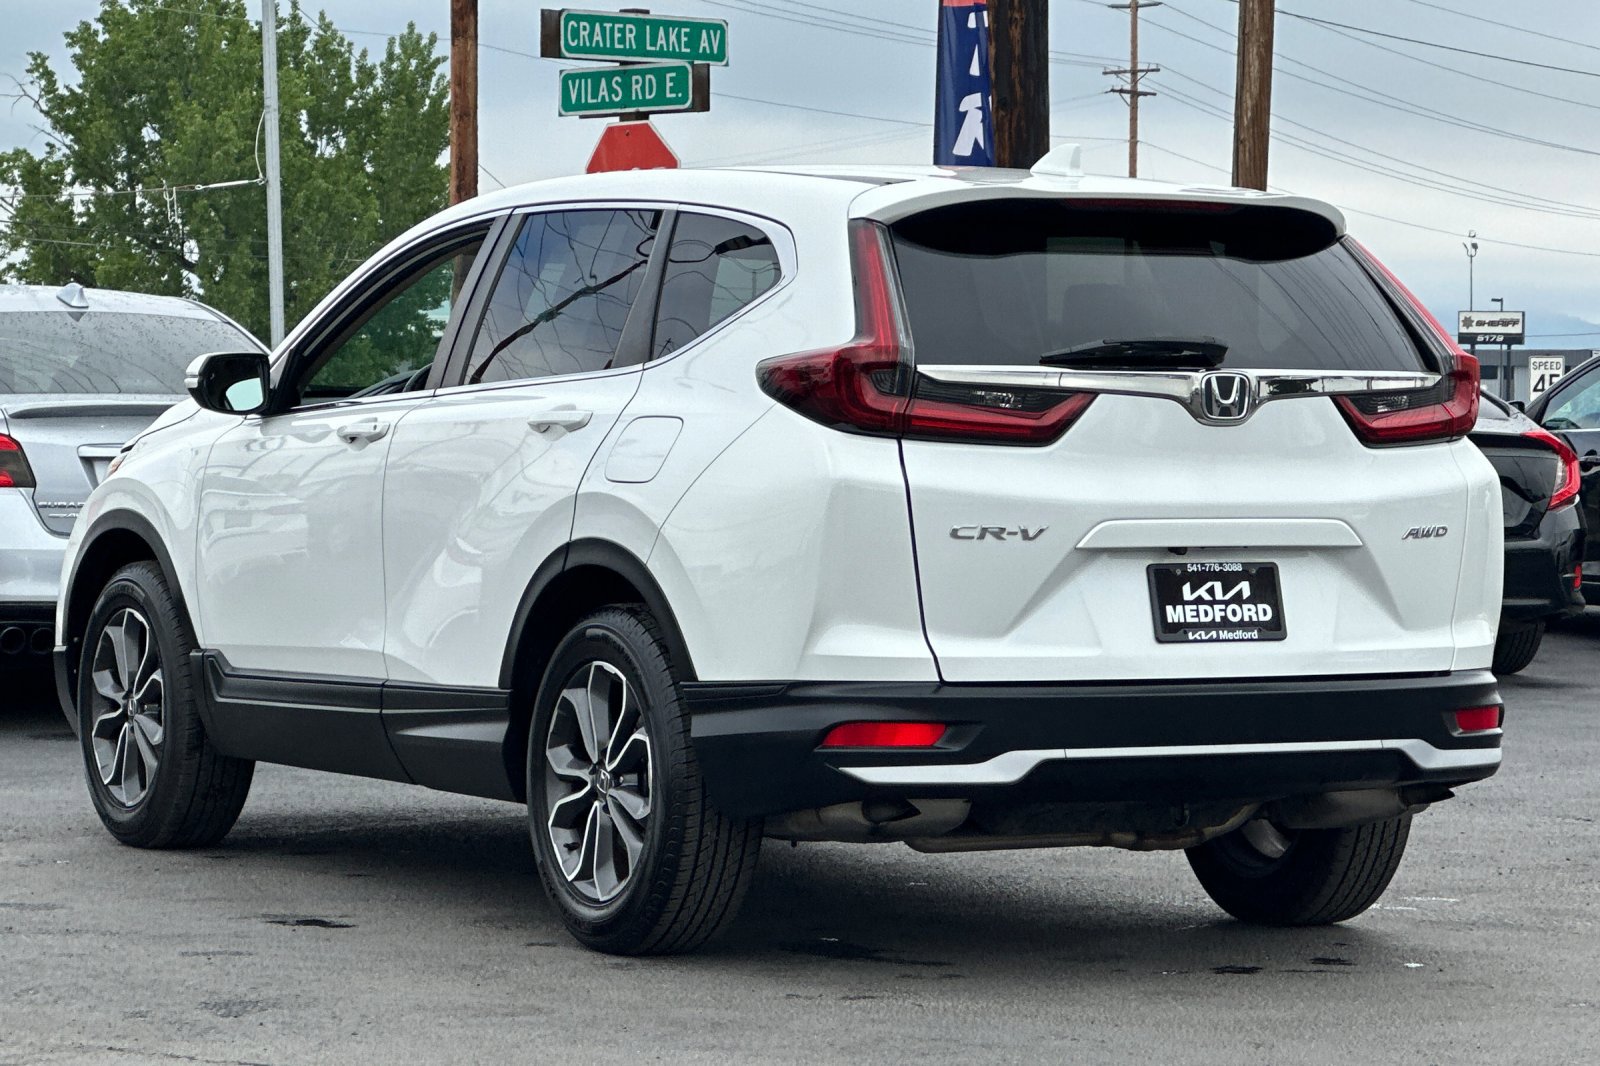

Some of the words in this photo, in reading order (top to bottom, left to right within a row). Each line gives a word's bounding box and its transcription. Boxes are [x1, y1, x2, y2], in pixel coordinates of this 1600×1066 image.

[567, 21, 636, 49] CRATER
[646, 25, 690, 53] LAKE
[699, 29, 721, 54] AV
[568, 76, 622, 104] VILAS
[631, 74, 657, 100] RD
[665, 72, 683, 98] E.
[1475, 319, 1520, 327] SHERIFF
[1532, 361, 1562, 370] SPEED
[950, 525, 1049, 541] CR-V
[1401, 525, 1448, 540] AWD
[1187, 563, 1243, 572] 541-776-3088
[1182, 581, 1251, 601] KIA
[1165, 604, 1273, 623] MEDFORD
[1219, 630, 1259, 640] Medford
